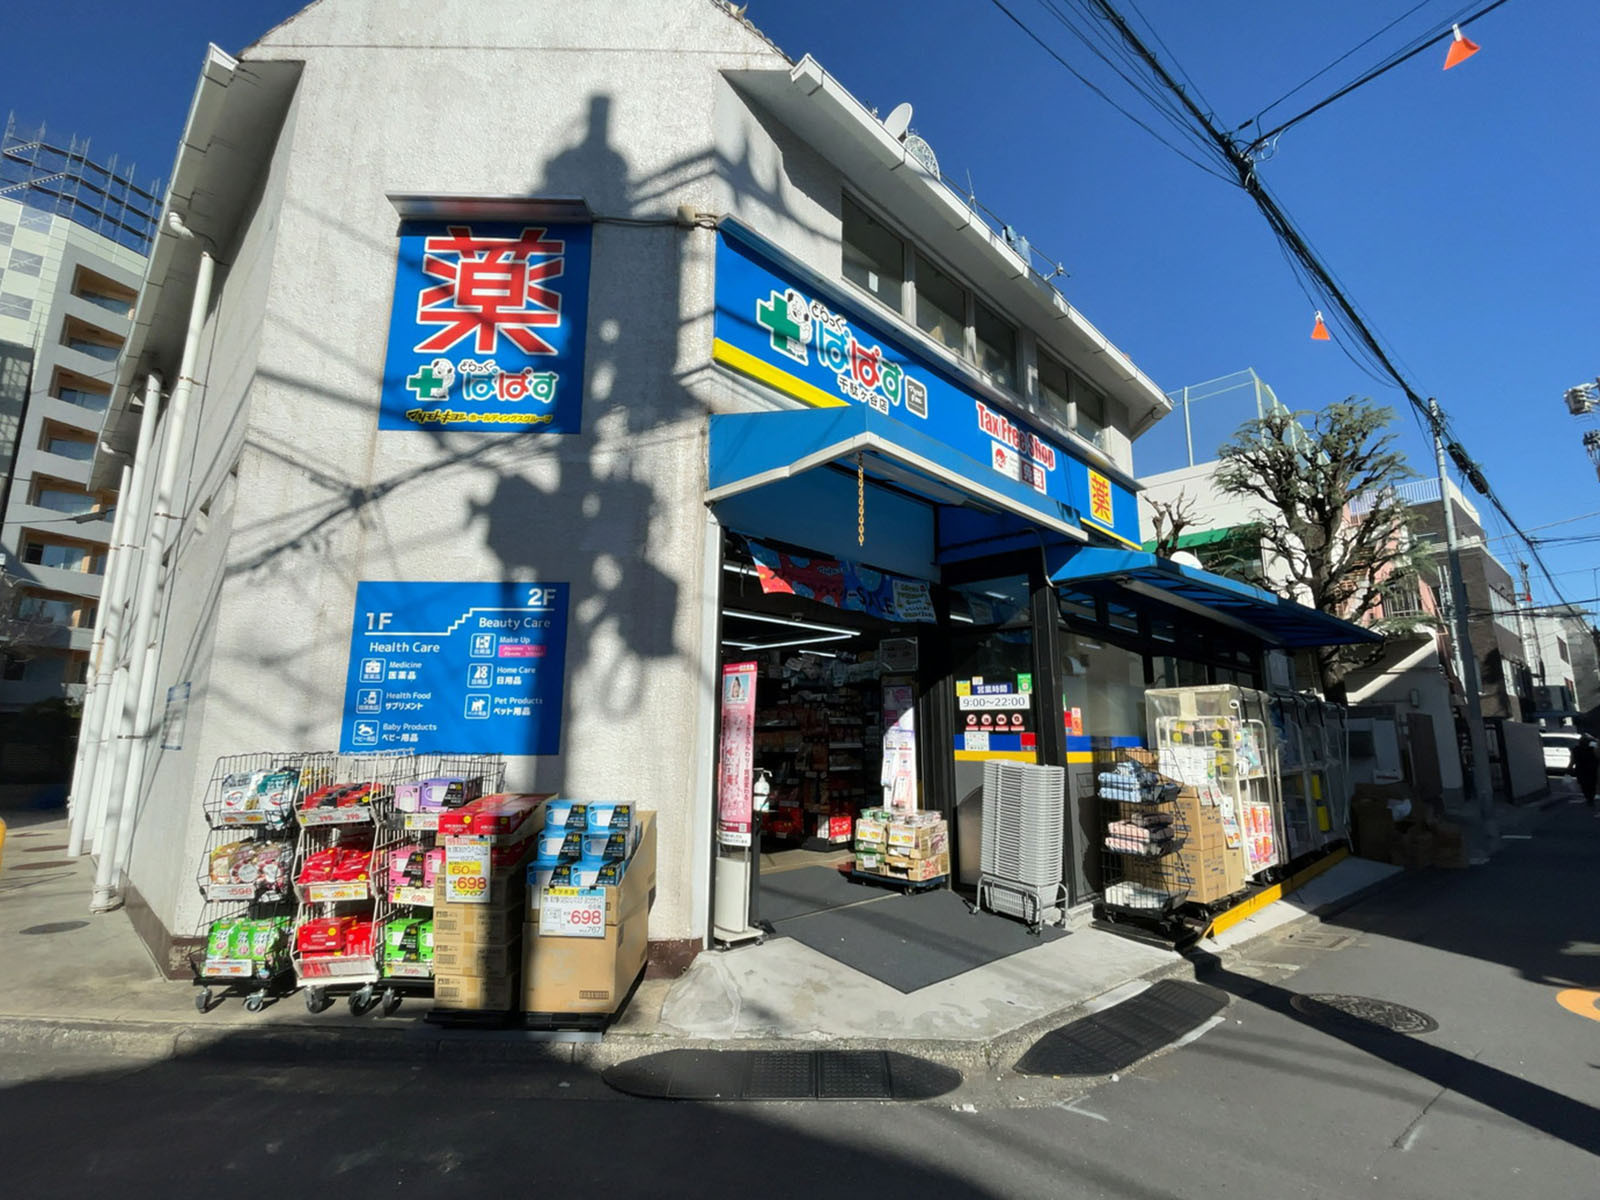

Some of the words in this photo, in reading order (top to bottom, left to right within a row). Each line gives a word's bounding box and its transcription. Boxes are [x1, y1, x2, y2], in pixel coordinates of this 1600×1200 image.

[414, 226, 565, 355] 薬
[817, 319, 904, 406] ぱぱす
[462, 367, 559, 403] ぱぱす
[976, 402, 999, 439] Tax
[999, 413, 1027, 455] Free
[1027, 432, 1056, 471] Shop
[1090, 474, 1111, 521] 薬
[528, 588, 557, 606] 2F
[366, 612, 393, 630] 1F
[478, 617, 521, 630] Beauty
[522, 618, 551, 628] Care
[499, 636, 519, 644] Make
[520, 636, 531, 645] Up
[369, 642, 410, 653] Health
[411, 643, 441, 653] Care
[389, 661, 422, 669] Medicine
[497, 666, 518, 674] Home
[519, 666, 536, 674] Care
[388, 671, 417, 680] 医薬品
[496, 677, 522, 685] 日用品
[386, 692, 411, 700] Health
[412, 692, 432, 700] Food
[494, 697, 507, 705] Pet
[508, 697, 543, 705] Products
[385, 702, 424, 711] サプリメント
[493, 707, 531, 716] ペット用品
[382, 723, 401, 732] Baby
[402, 723, 437, 731] Products
[382, 733, 419, 743] ベビー用品
[457, 876, 487, 890] 698
[571, 910, 601, 925] 698
